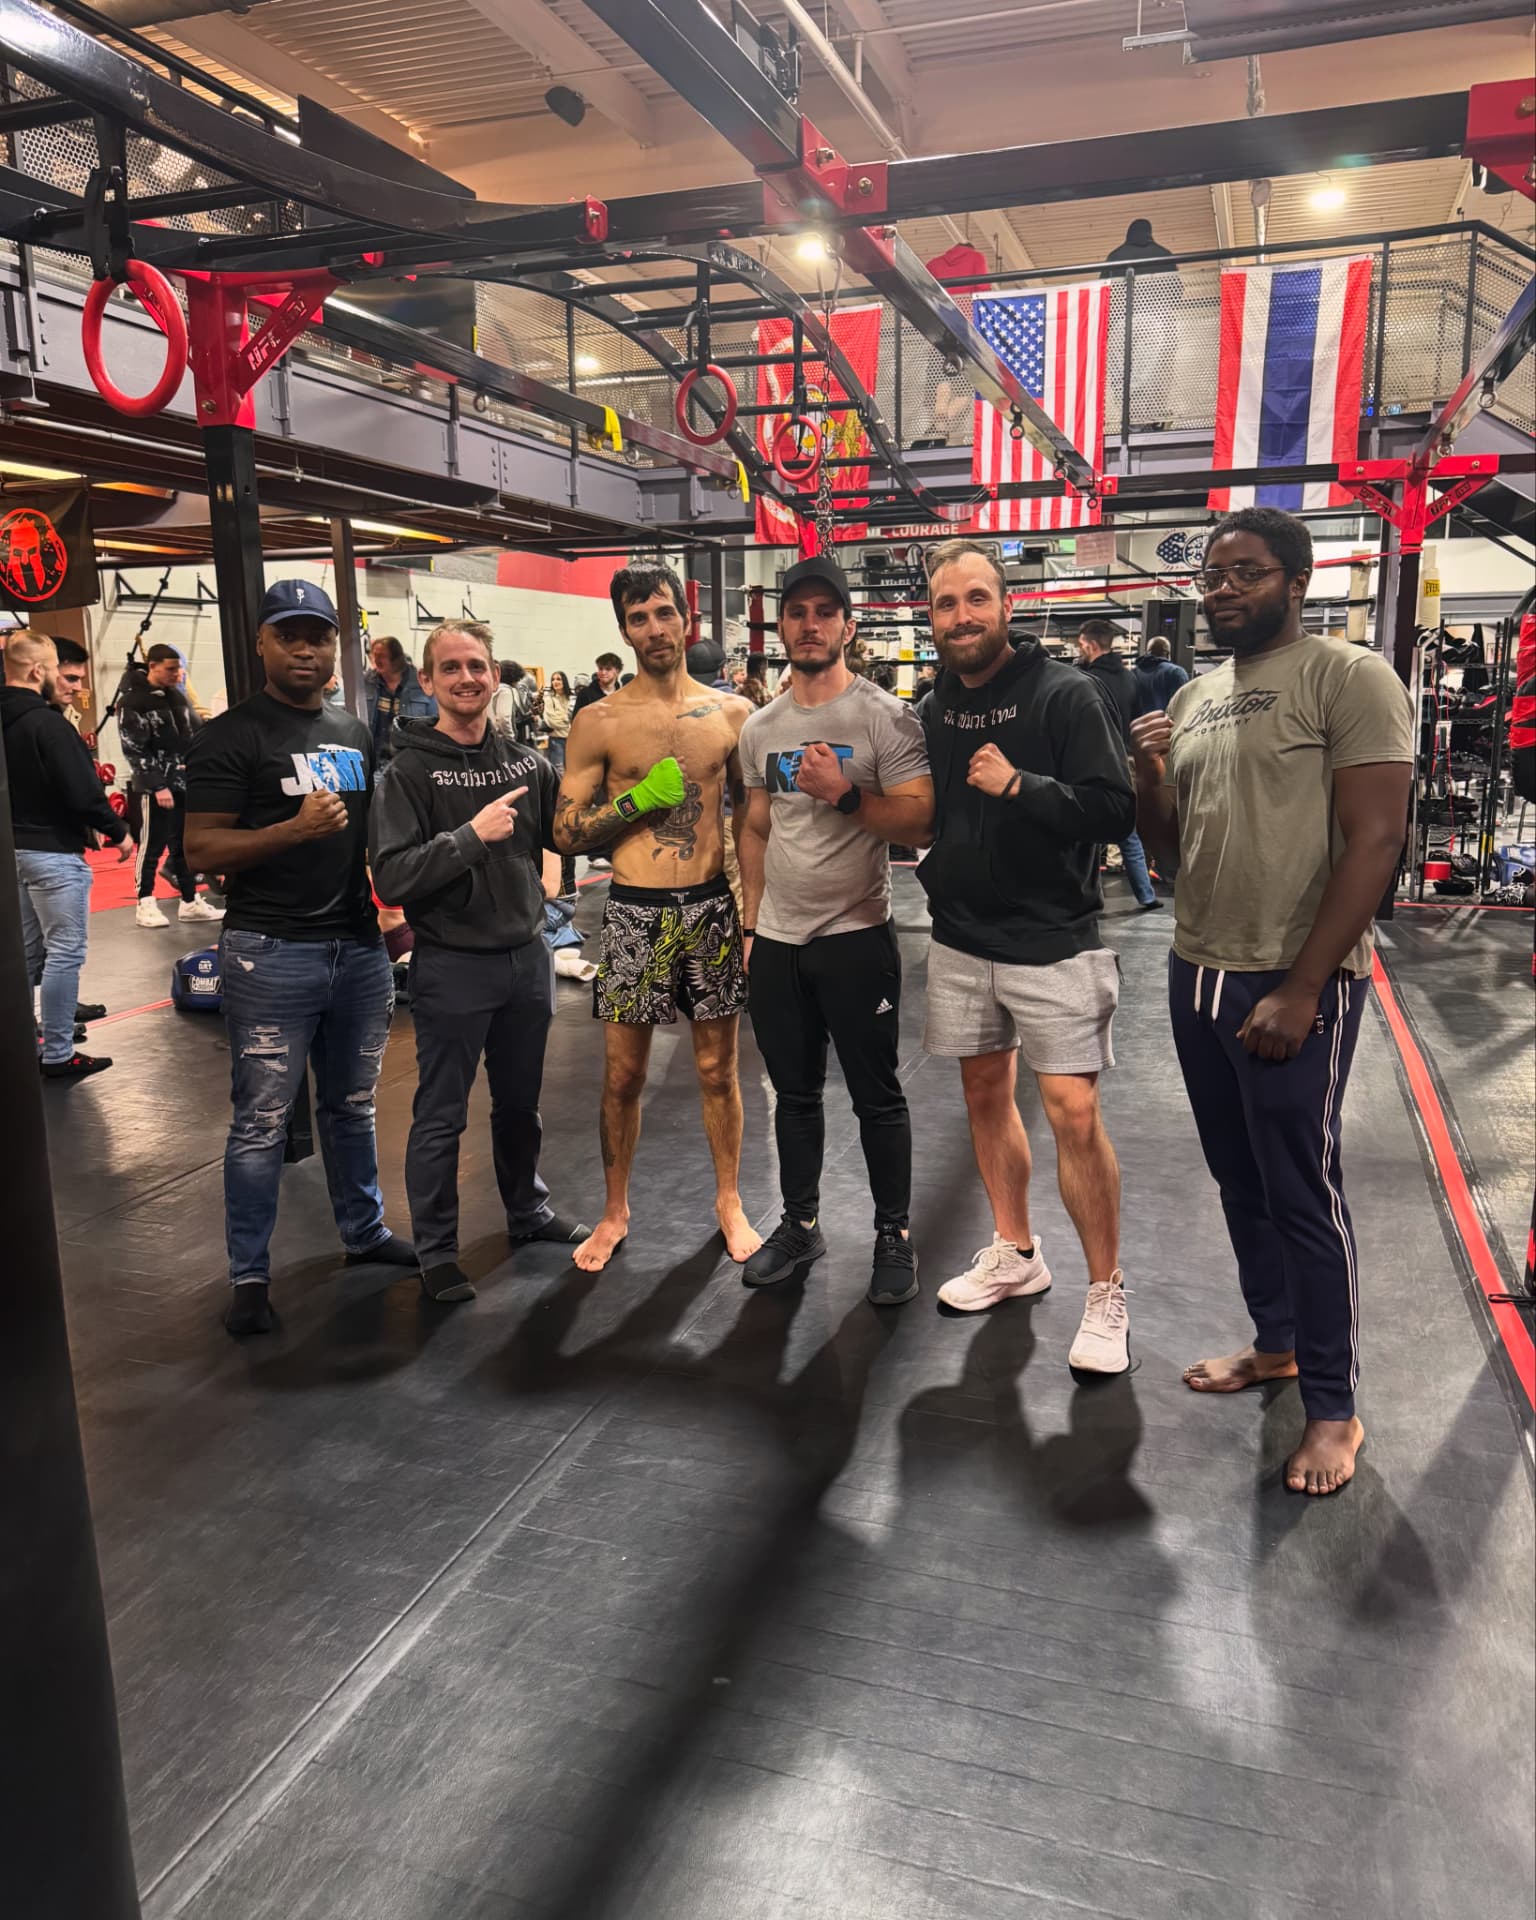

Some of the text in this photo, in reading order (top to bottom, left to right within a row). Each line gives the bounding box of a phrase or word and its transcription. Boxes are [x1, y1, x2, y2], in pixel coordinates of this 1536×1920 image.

[891, 523, 960, 537] COURAGE
[1184, 688, 1281, 732] Brixton
[1194, 718, 1251, 736] COMPANY
